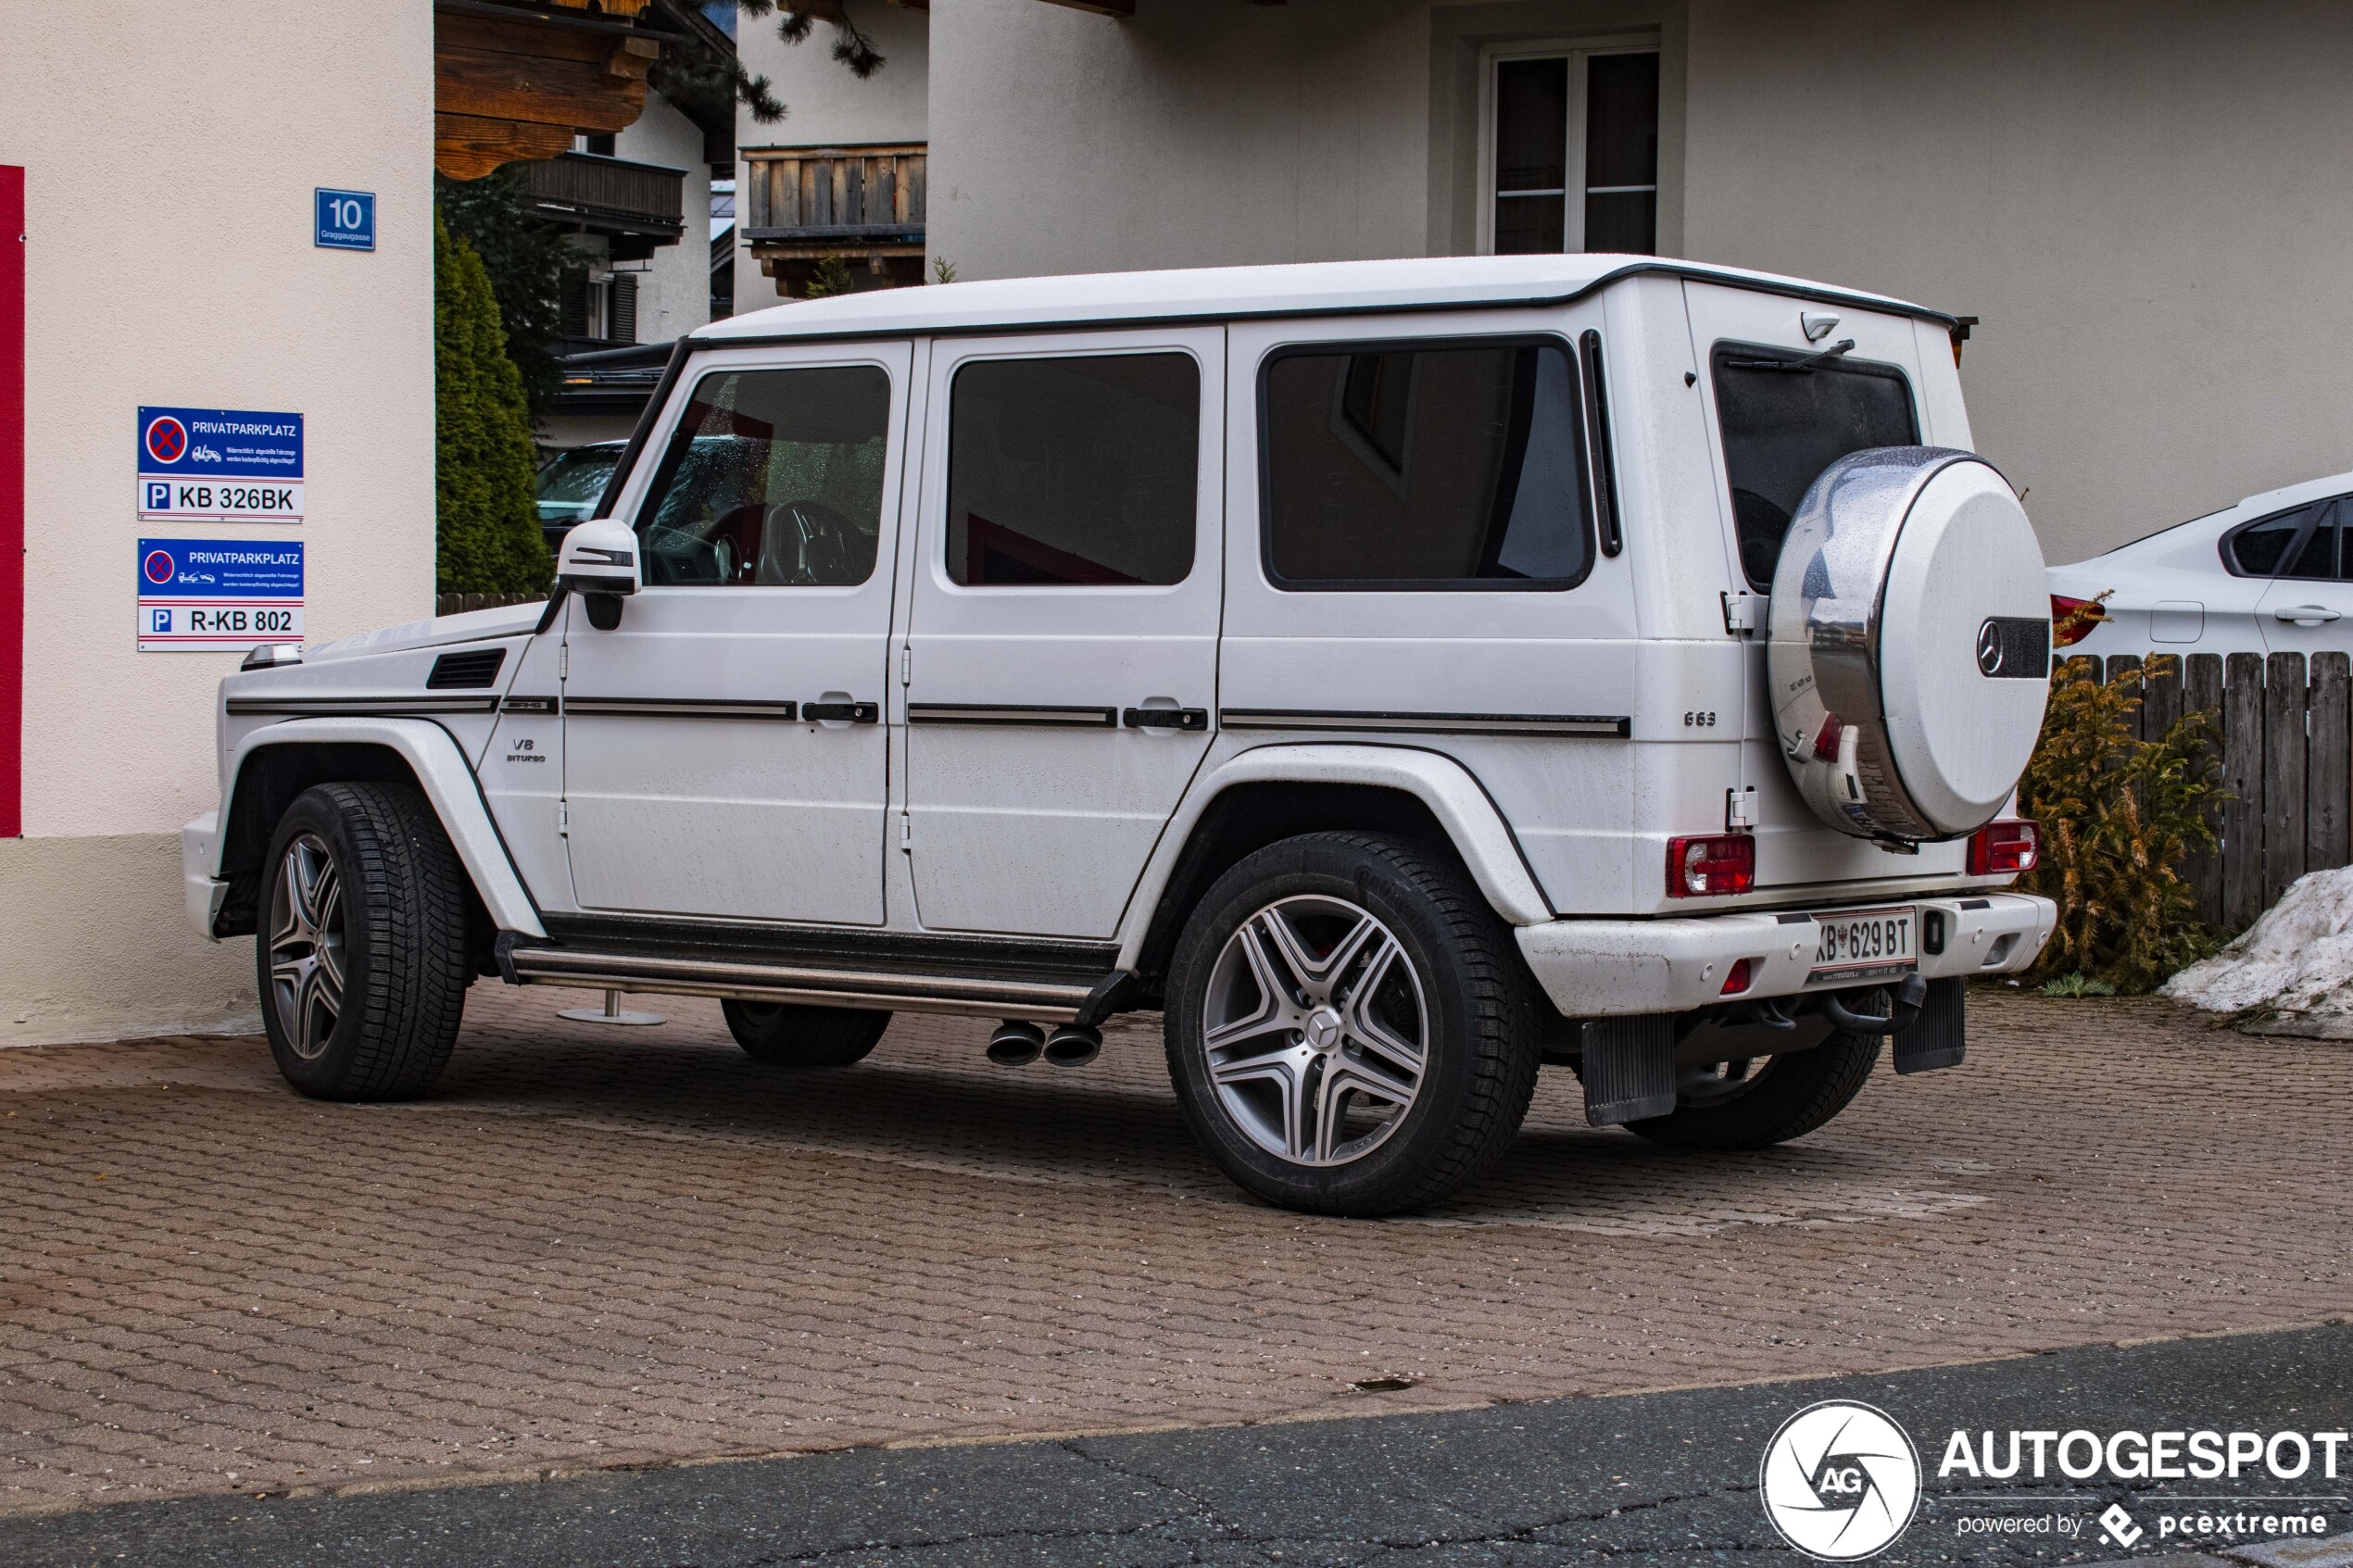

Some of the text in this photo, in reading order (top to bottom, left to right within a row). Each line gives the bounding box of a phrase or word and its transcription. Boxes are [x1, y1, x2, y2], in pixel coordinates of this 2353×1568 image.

[329, 198, 362, 230] 10
[321, 230, 371, 242] Graggaugasse
[192, 421, 296, 437] PRIVATPARKPLATZ
[226, 446, 255, 455] Widerrechtlich
[255, 447, 276, 456] abgestellte
[241, 456, 270, 464] kostenpflichtig
[180, 486, 212, 508] KB
[220, 487, 294, 510] 326BK
[189, 552, 299, 565] PRIVATPARKPLATZ
[191, 610, 247, 632] R-KB
[255, 610, 292, 632] 802
[513, 738, 535, 751] V8
[507, 754, 547, 763] BITURBO
[1850, 921, 1881, 959] 629
[1886, 919, 1908, 955] BT
